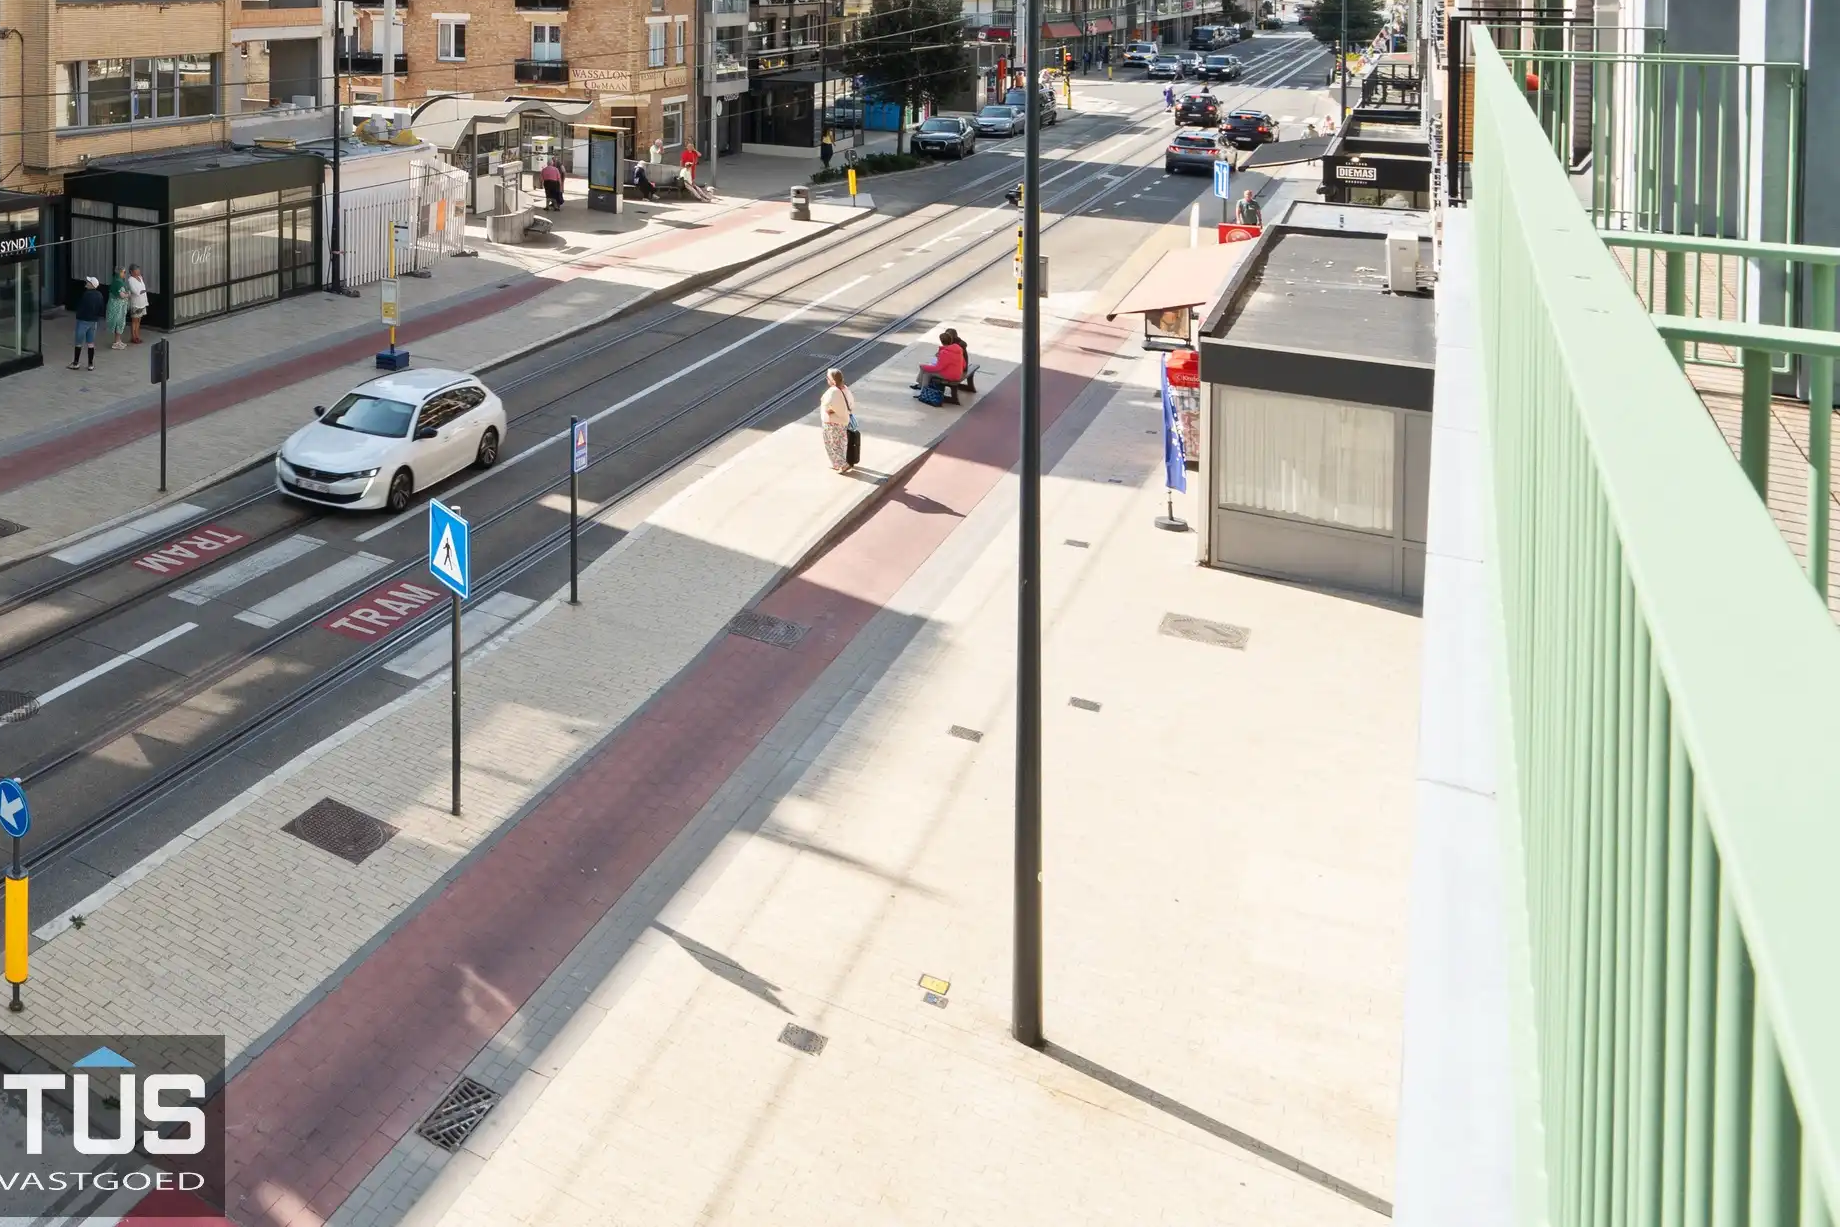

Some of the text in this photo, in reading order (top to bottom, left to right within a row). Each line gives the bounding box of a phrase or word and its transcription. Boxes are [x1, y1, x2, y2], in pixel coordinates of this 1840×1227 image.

[572, 69, 628, 80] WASSALON
[1339, 168, 1374, 178] DIEMAS
[0, 235, 36, 253] SYNDIX
[134, 529, 244, 573] TRAM
[329, 583, 441, 635] TRAM
